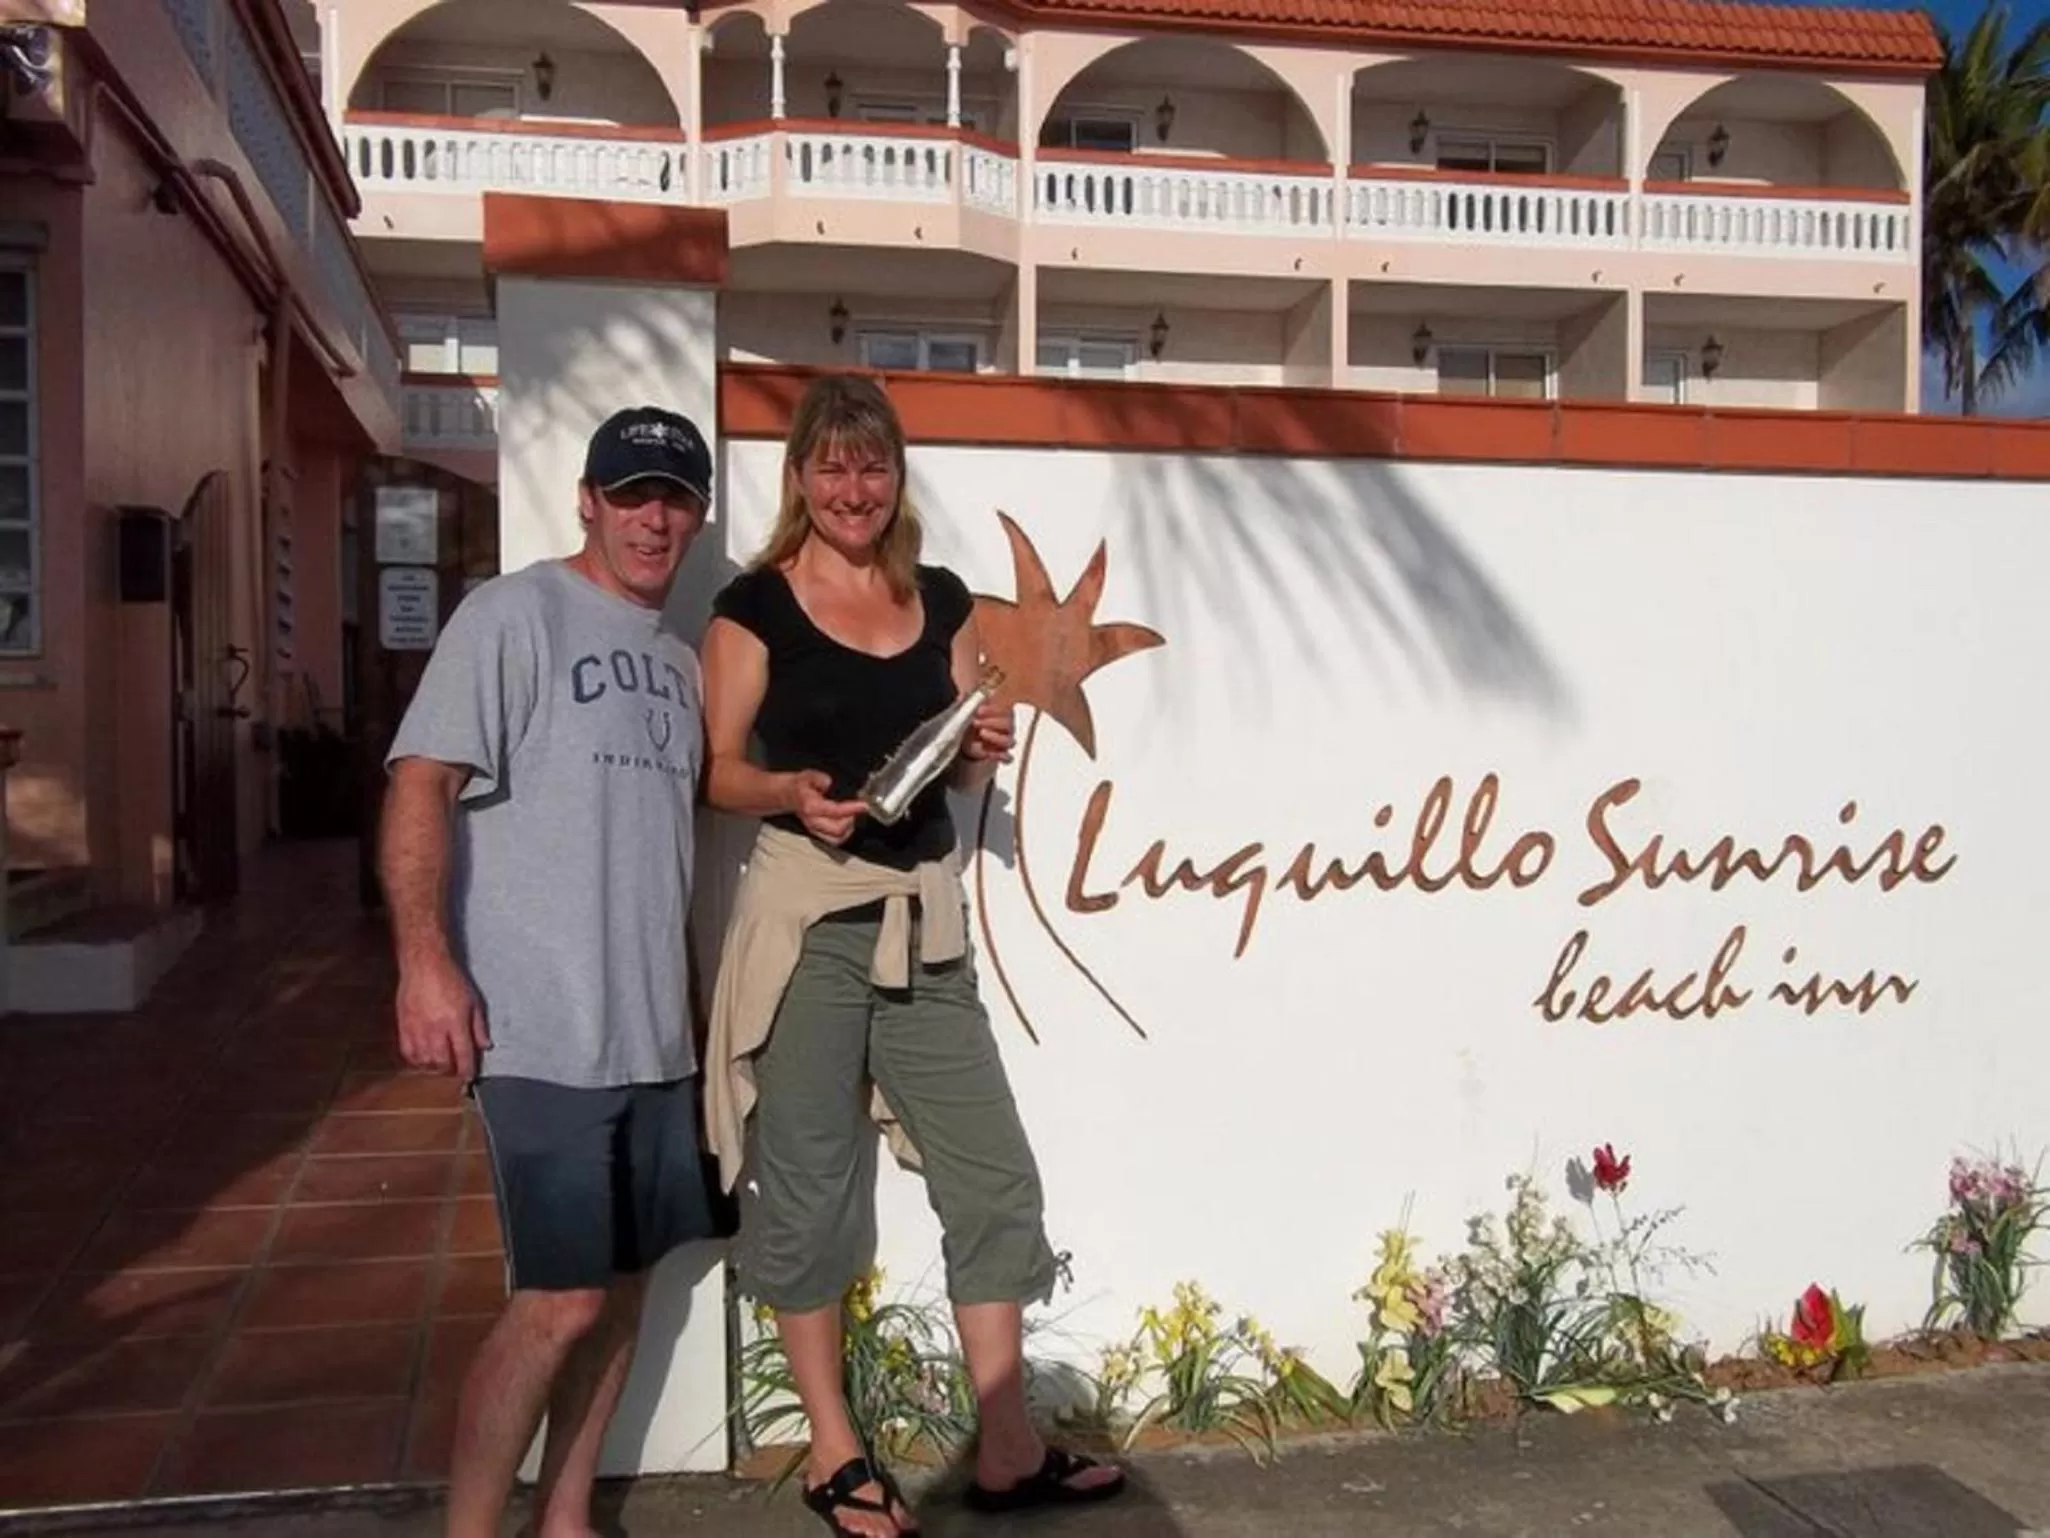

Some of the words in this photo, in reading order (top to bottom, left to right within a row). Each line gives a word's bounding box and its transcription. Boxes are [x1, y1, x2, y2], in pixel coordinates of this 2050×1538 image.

[1064, 771, 1556, 960] Luquillo
[1577, 777, 1957, 907] Sunrise
[1532, 924, 1753, 1025] beach
[1770, 945, 1919, 1017] inn
